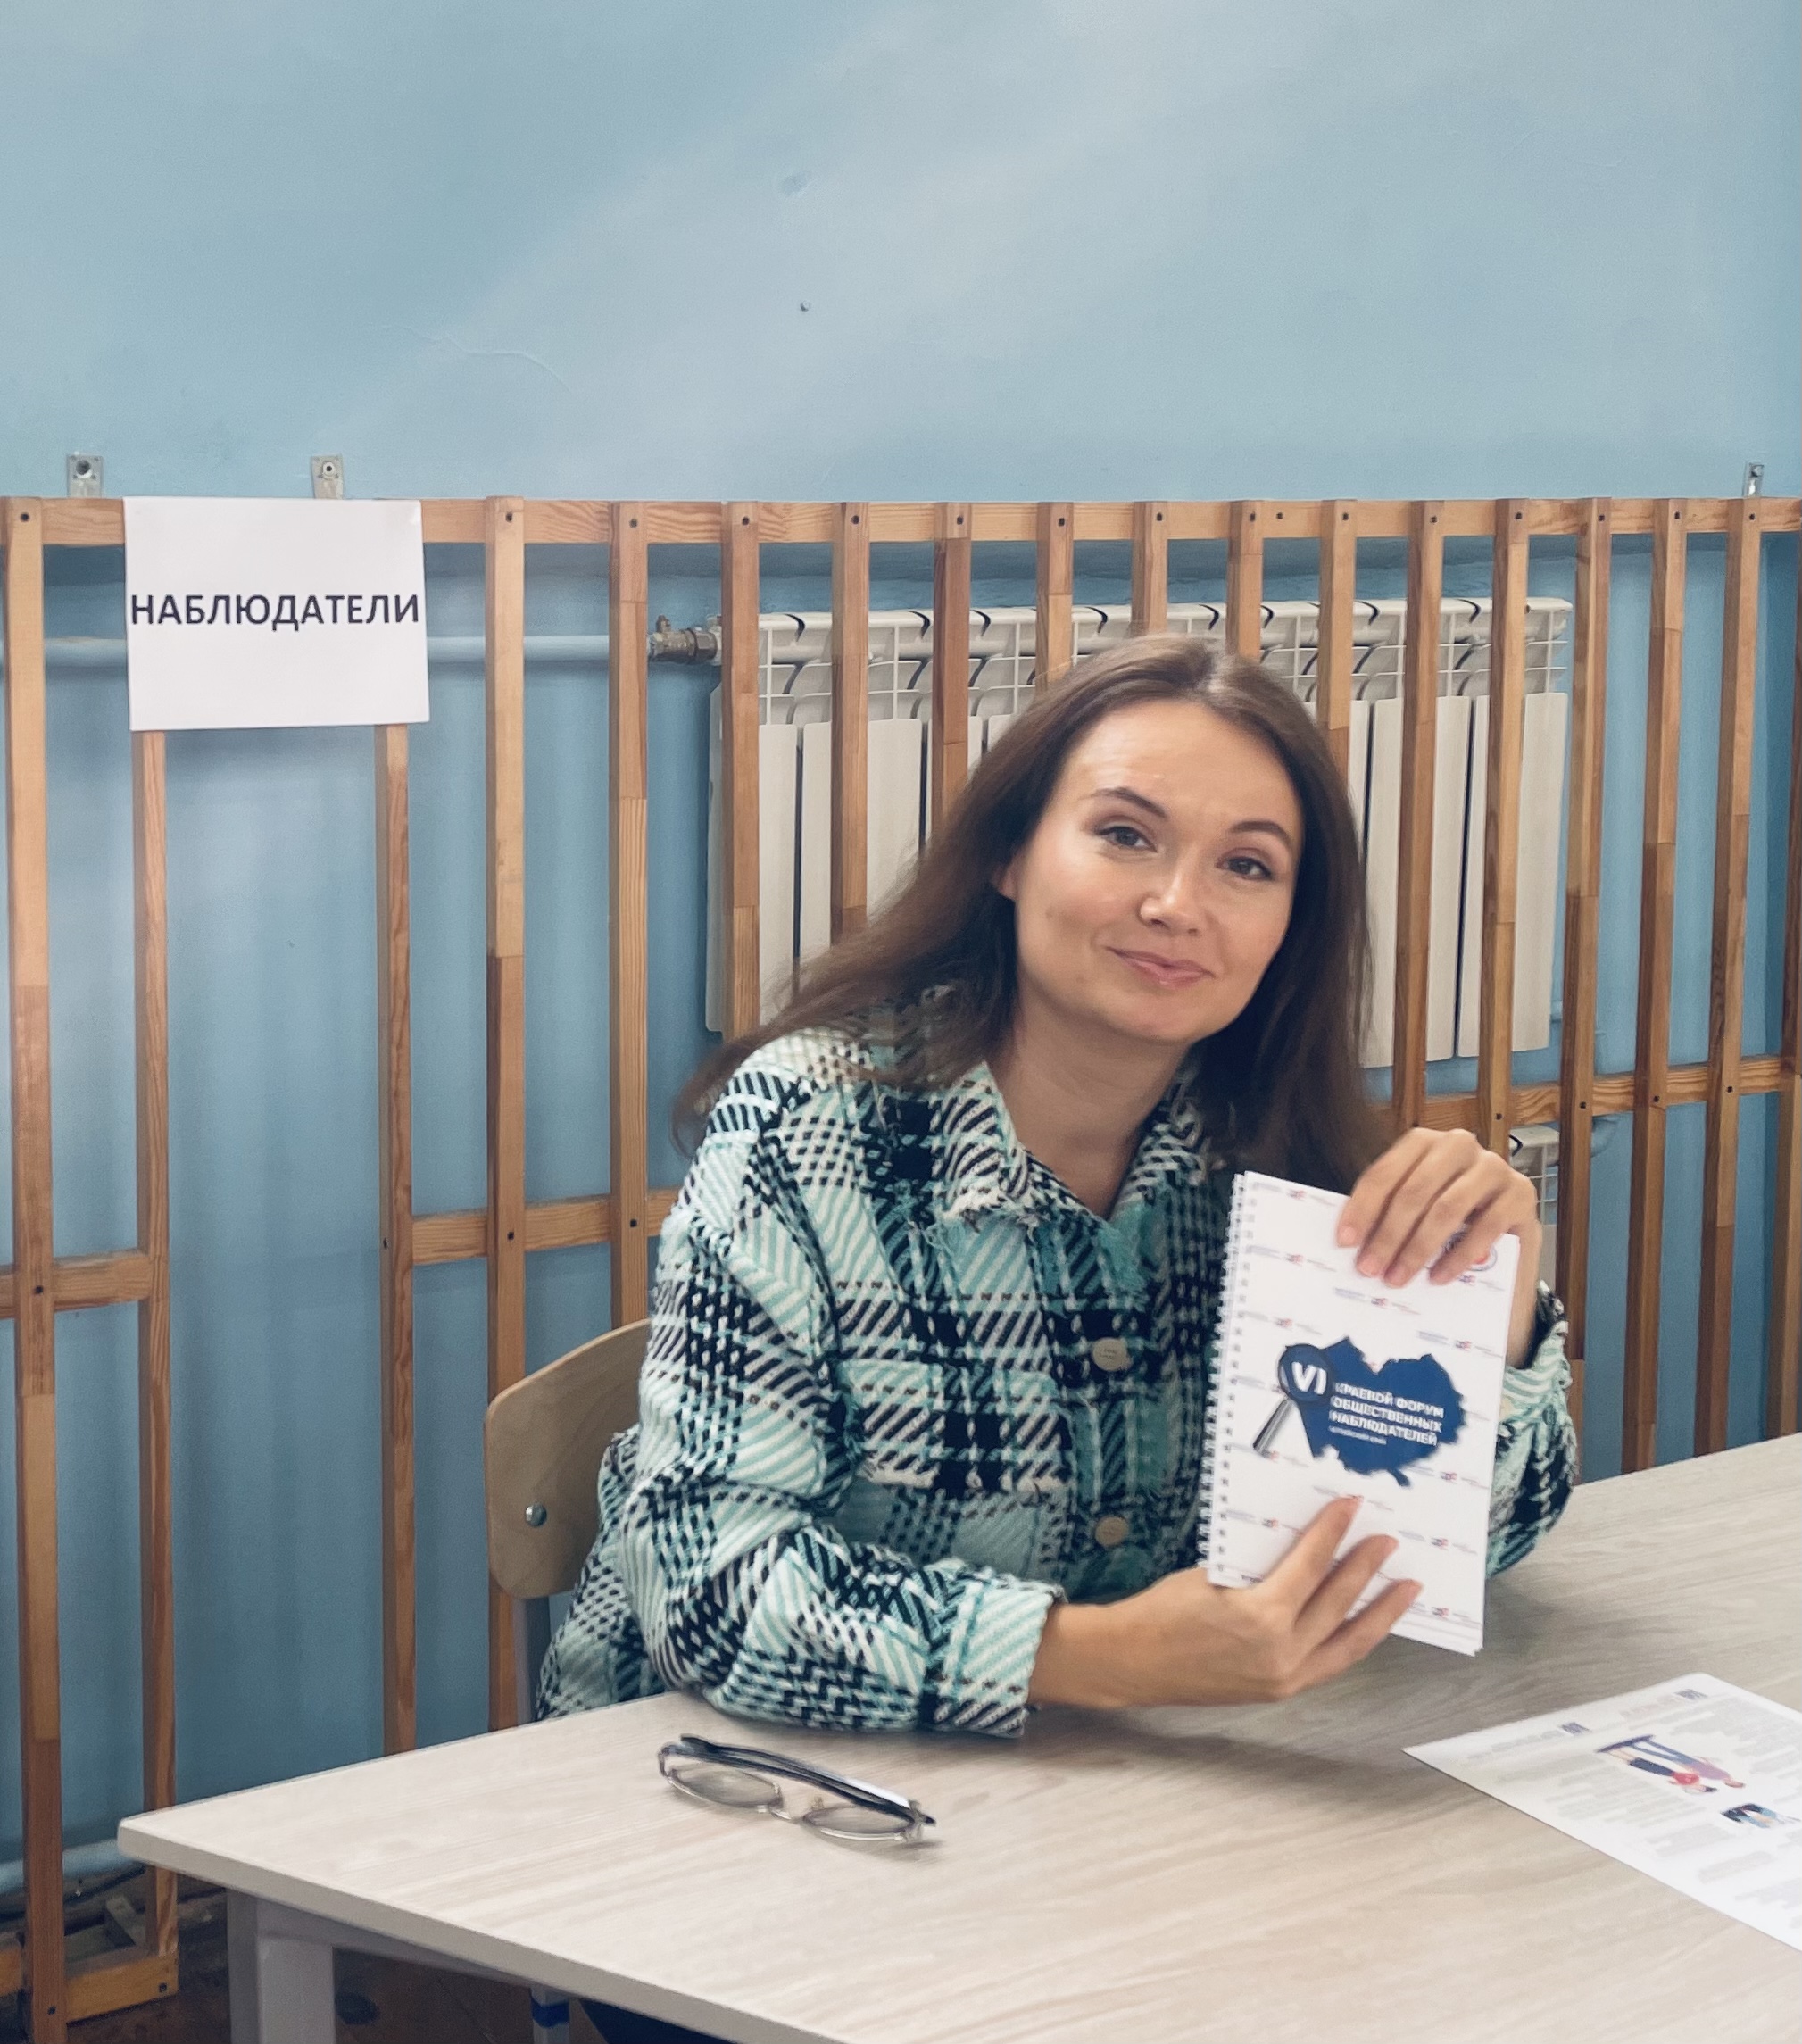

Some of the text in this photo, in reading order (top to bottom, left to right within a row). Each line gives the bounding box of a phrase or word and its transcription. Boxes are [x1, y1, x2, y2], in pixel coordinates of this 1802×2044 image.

[131, 594, 419, 631] НАБЛЮДАТЕЛИ
[1291, 1361, 1327, 1395] VI
[1330, 1395, 1442, 1433] ОБЩЕСТВЕННЫХ
[1394, 1396, 1444, 1418] ФОРУМ
[1329, 1410, 1438, 1446] НАБЛЮДАТЕЛЕЙ
